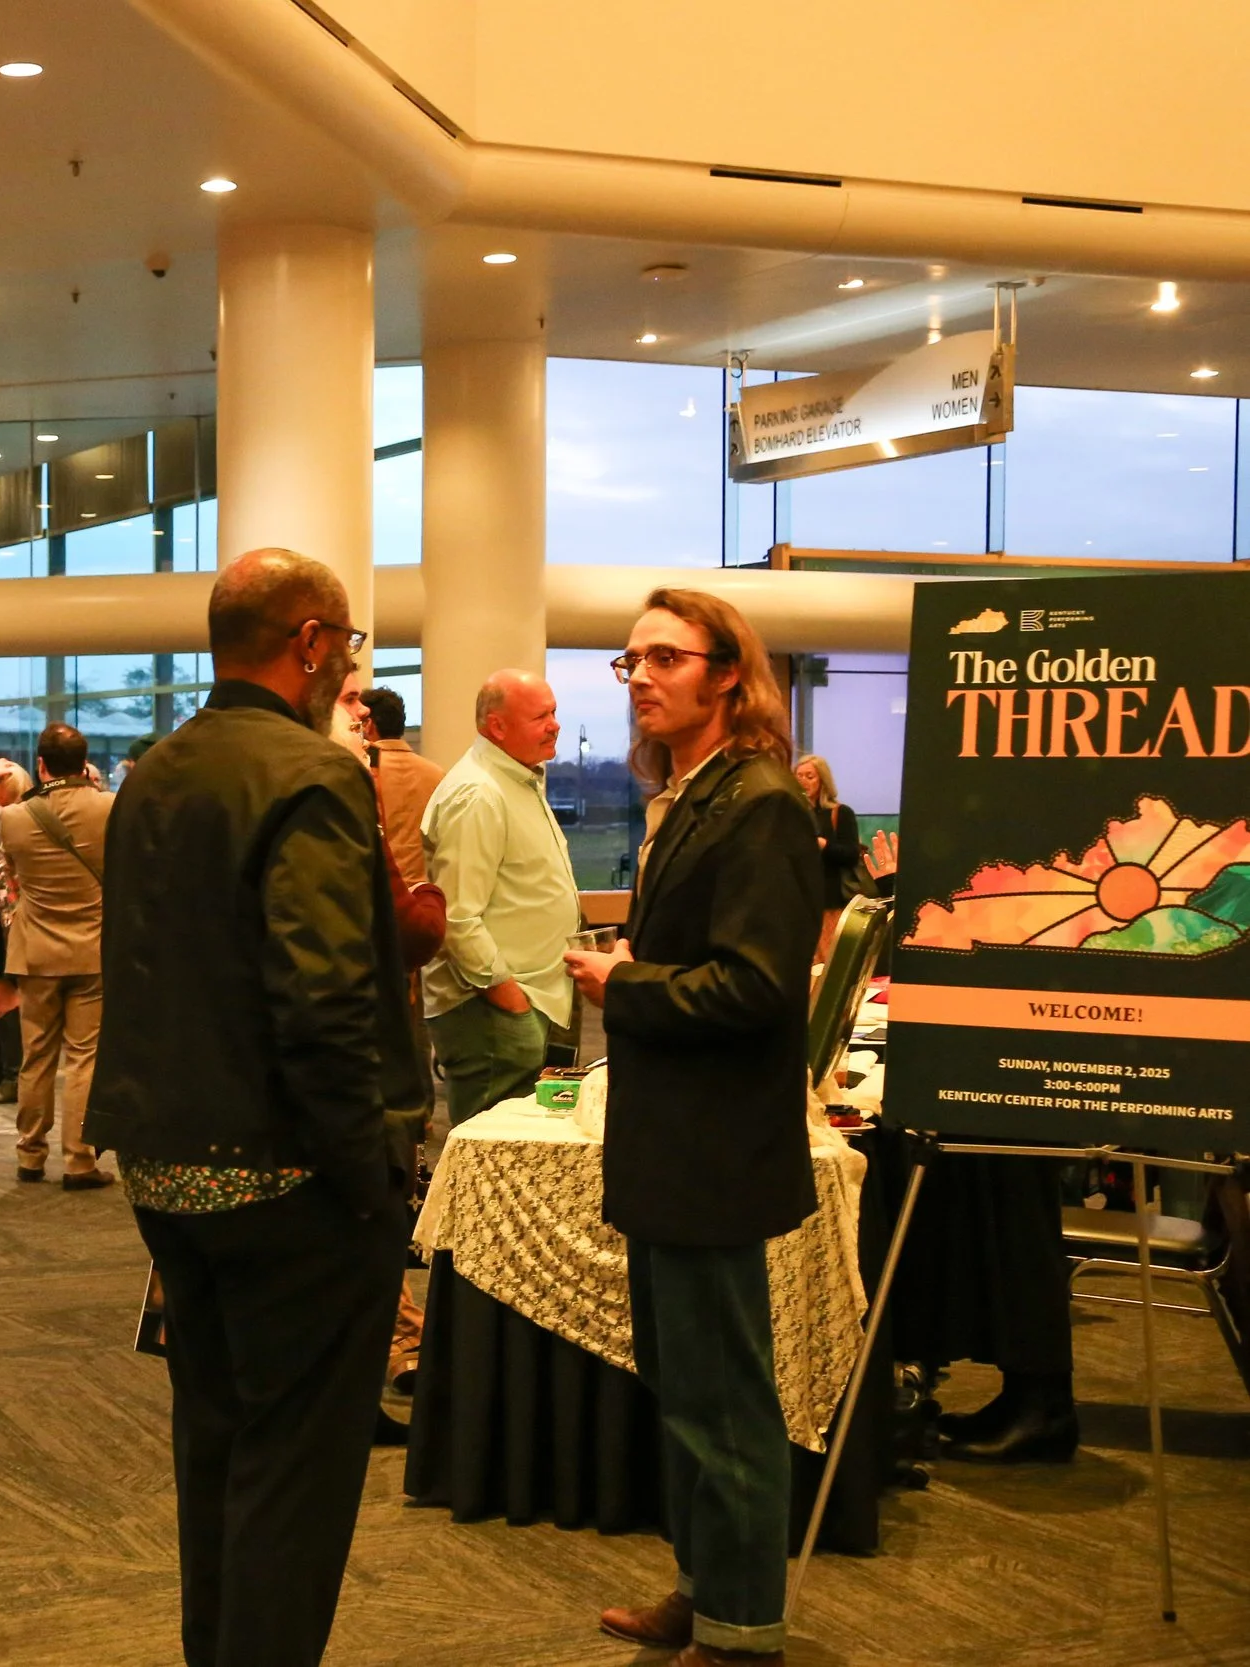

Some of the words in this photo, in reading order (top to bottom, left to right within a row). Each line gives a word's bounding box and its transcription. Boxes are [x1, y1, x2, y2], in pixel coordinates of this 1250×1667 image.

[952, 370, 979, 391] MEN
[754, 406, 799, 431] PARKING
[800, 396, 844, 420] GARAGE
[932, 398, 979, 421] WOMEN
[754, 429, 804, 454] BOMHARD
[806, 417, 862, 444] ELEVATOR
[950, 651, 1017, 684] The
[1026, 648, 1157, 683] Golden
[946, 685, 1250, 758] THREAD
[1028, 1002, 1143, 1023] WELCOME!
[999, 1058, 1050, 1072] SUNDAY,
[1053, 1062, 1123, 1076] NOVEMBER
[1124, 1066, 1137, 1078] 2,
[1139, 1067, 1171, 1079] 2025
[1043, 1079, 1121, 1094] 3:00-6:00PM
[938, 1089, 1003, 1104] KENTUCKY
[1004, 1094, 1053, 1107] CENTER
[1055, 1098, 1081, 1110] FOR
[1083, 1100, 1109, 1111] THE
[1110, 1101, 1197, 1118] PERFORMING
[1198, 1108, 1234, 1120] ARTS
